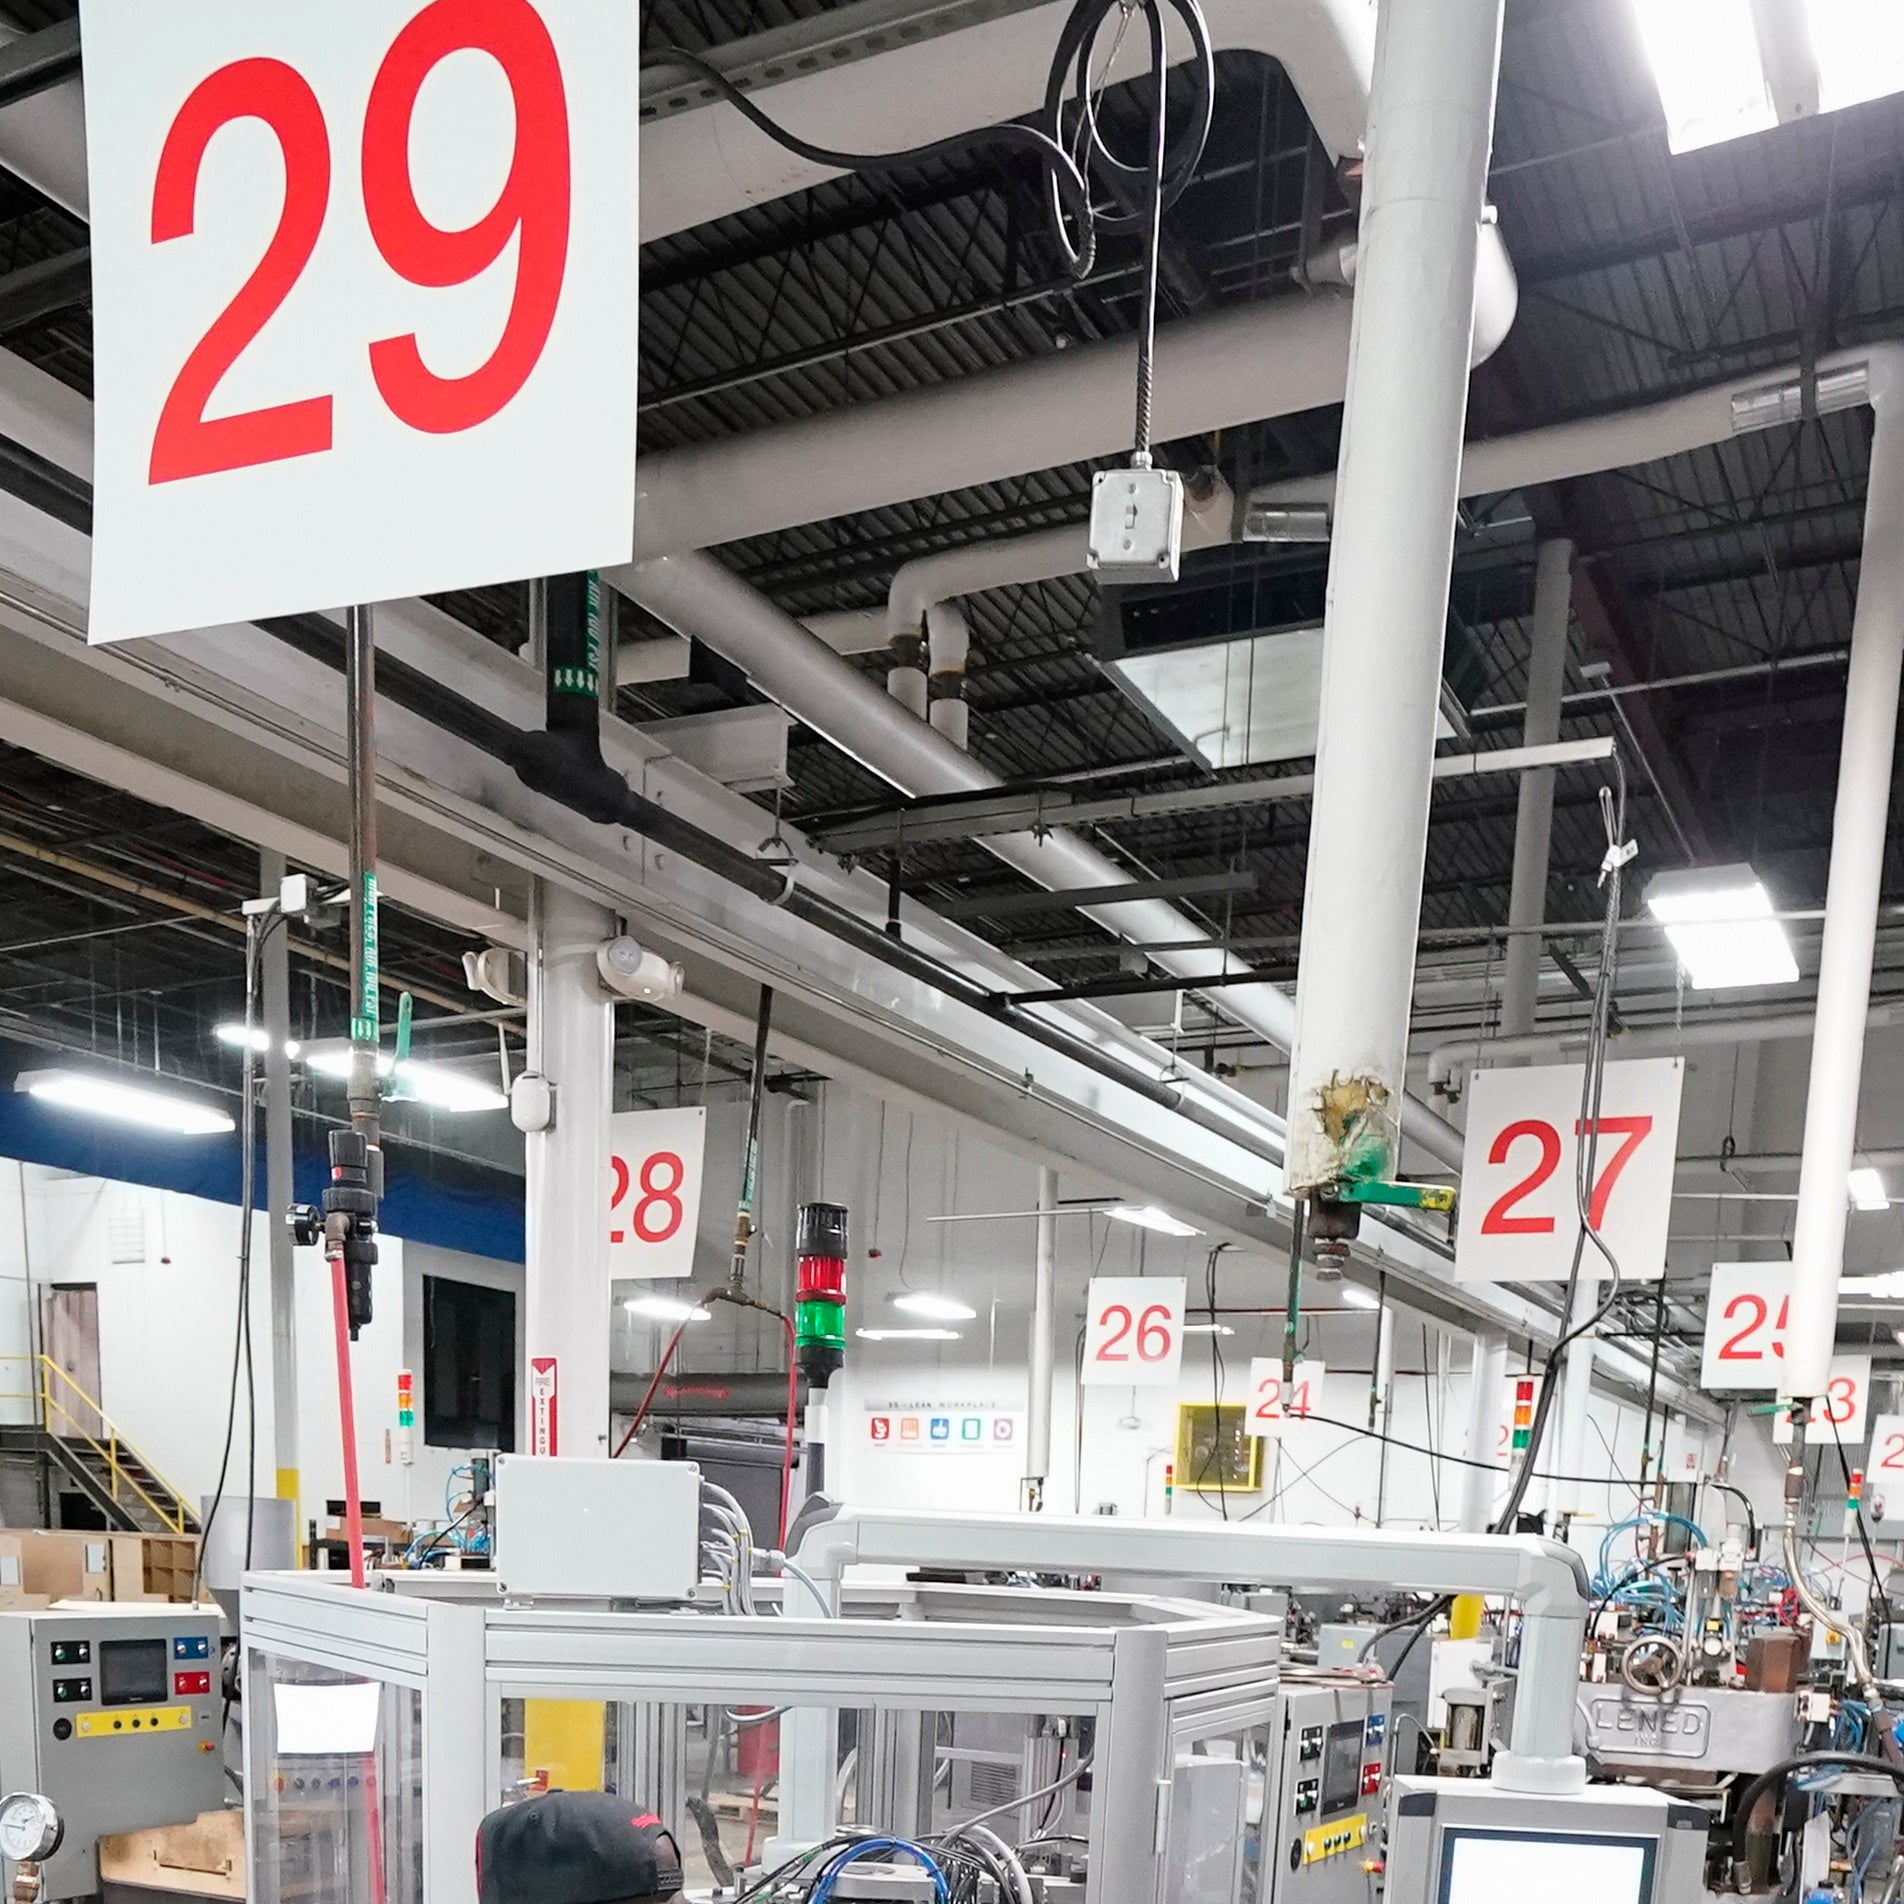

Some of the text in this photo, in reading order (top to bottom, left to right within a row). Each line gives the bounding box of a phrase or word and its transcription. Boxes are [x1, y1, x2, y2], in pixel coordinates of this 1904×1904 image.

[148, 0, 571, 486] 29
[1480, 1115, 1653, 1235] 27
[1096, 1304, 1172, 1362] 26
[1255, 1378, 1311, 1421] 24
[1784, 1377, 1856, 1424] 3
[1596, 1704, 1702, 1735] LENED
